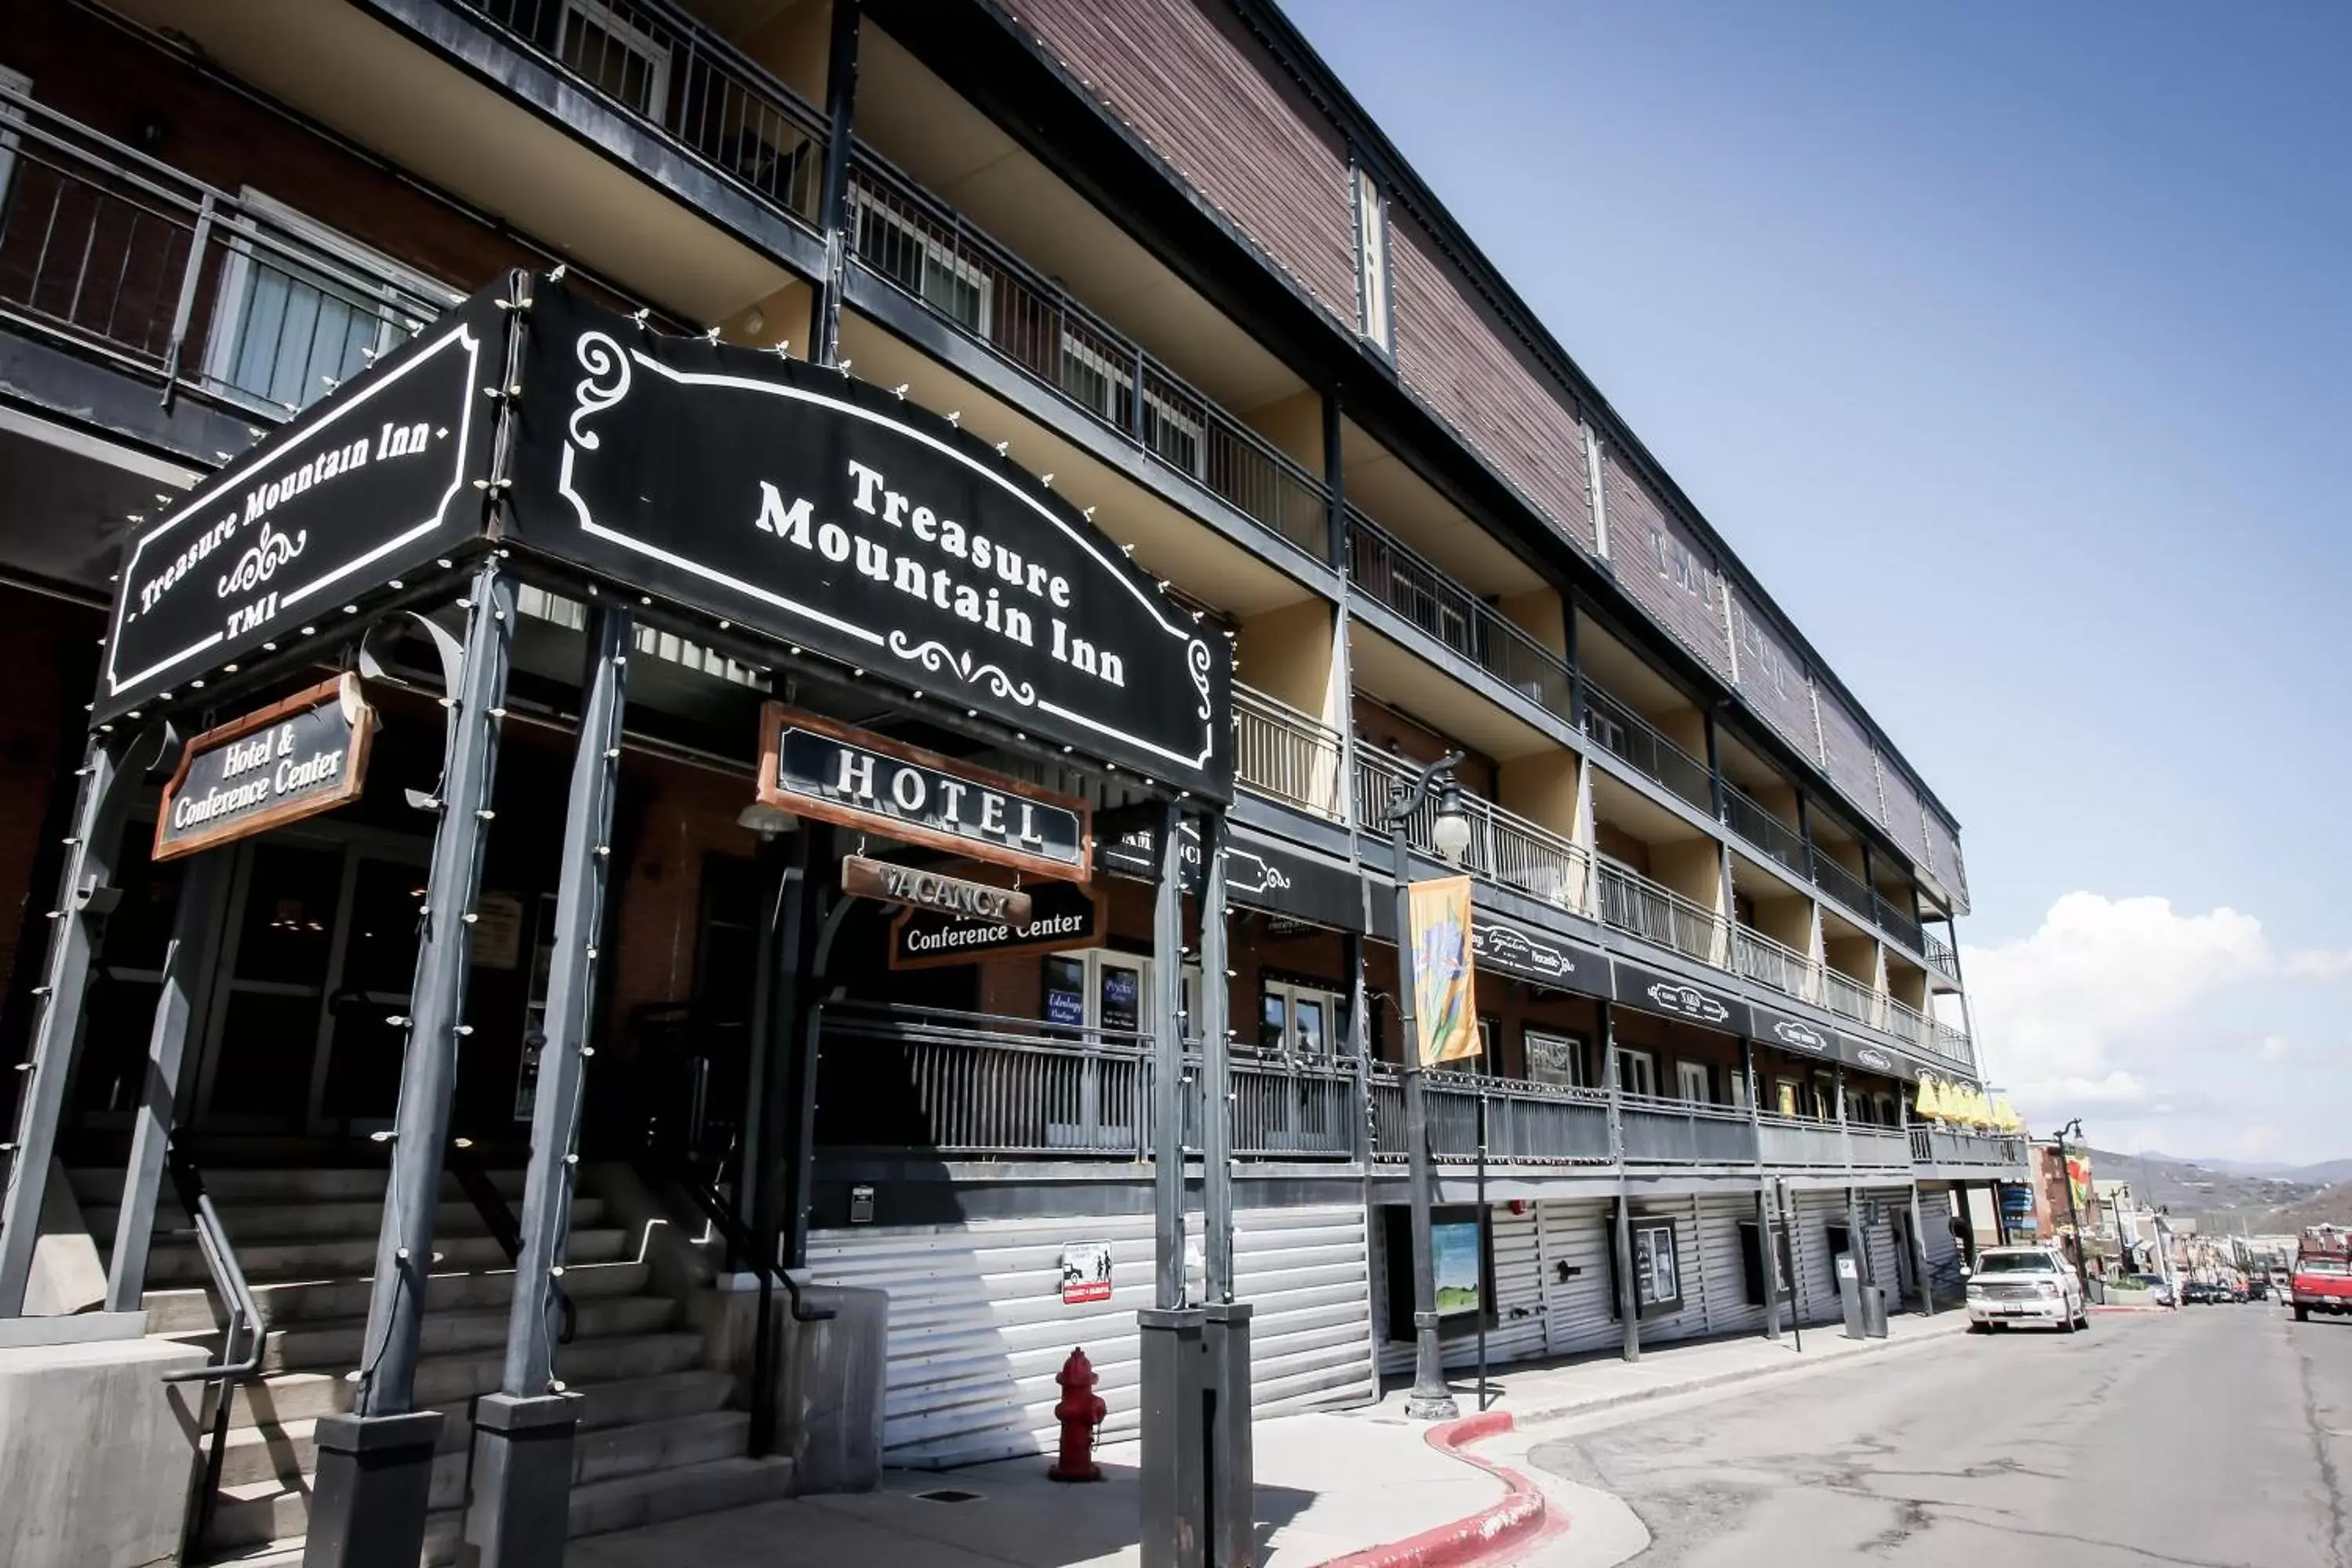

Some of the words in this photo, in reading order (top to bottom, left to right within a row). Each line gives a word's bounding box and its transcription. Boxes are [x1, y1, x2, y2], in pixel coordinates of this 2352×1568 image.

[141, 512, 237, 615] Treasure
[242, 437, 368, 526] Mountain
[376, 423, 429, 461] Inn
[848, 459, 1070, 608] Treasure
[227, 591, 278, 640] TMI
[755, 480, 1033, 647] Mountain
[1051, 618, 1124, 688] Inn
[175, 777, 270, 829] Conference
[275, 750, 343, 795] Center
[223, 731, 274, 779] Hotel
[278, 724, 295, 757] &
[837, 749, 1043, 844] HOTEL
[879, 868, 1008, 919] VACANCY
[908, 925, 1007, 951] Conference
